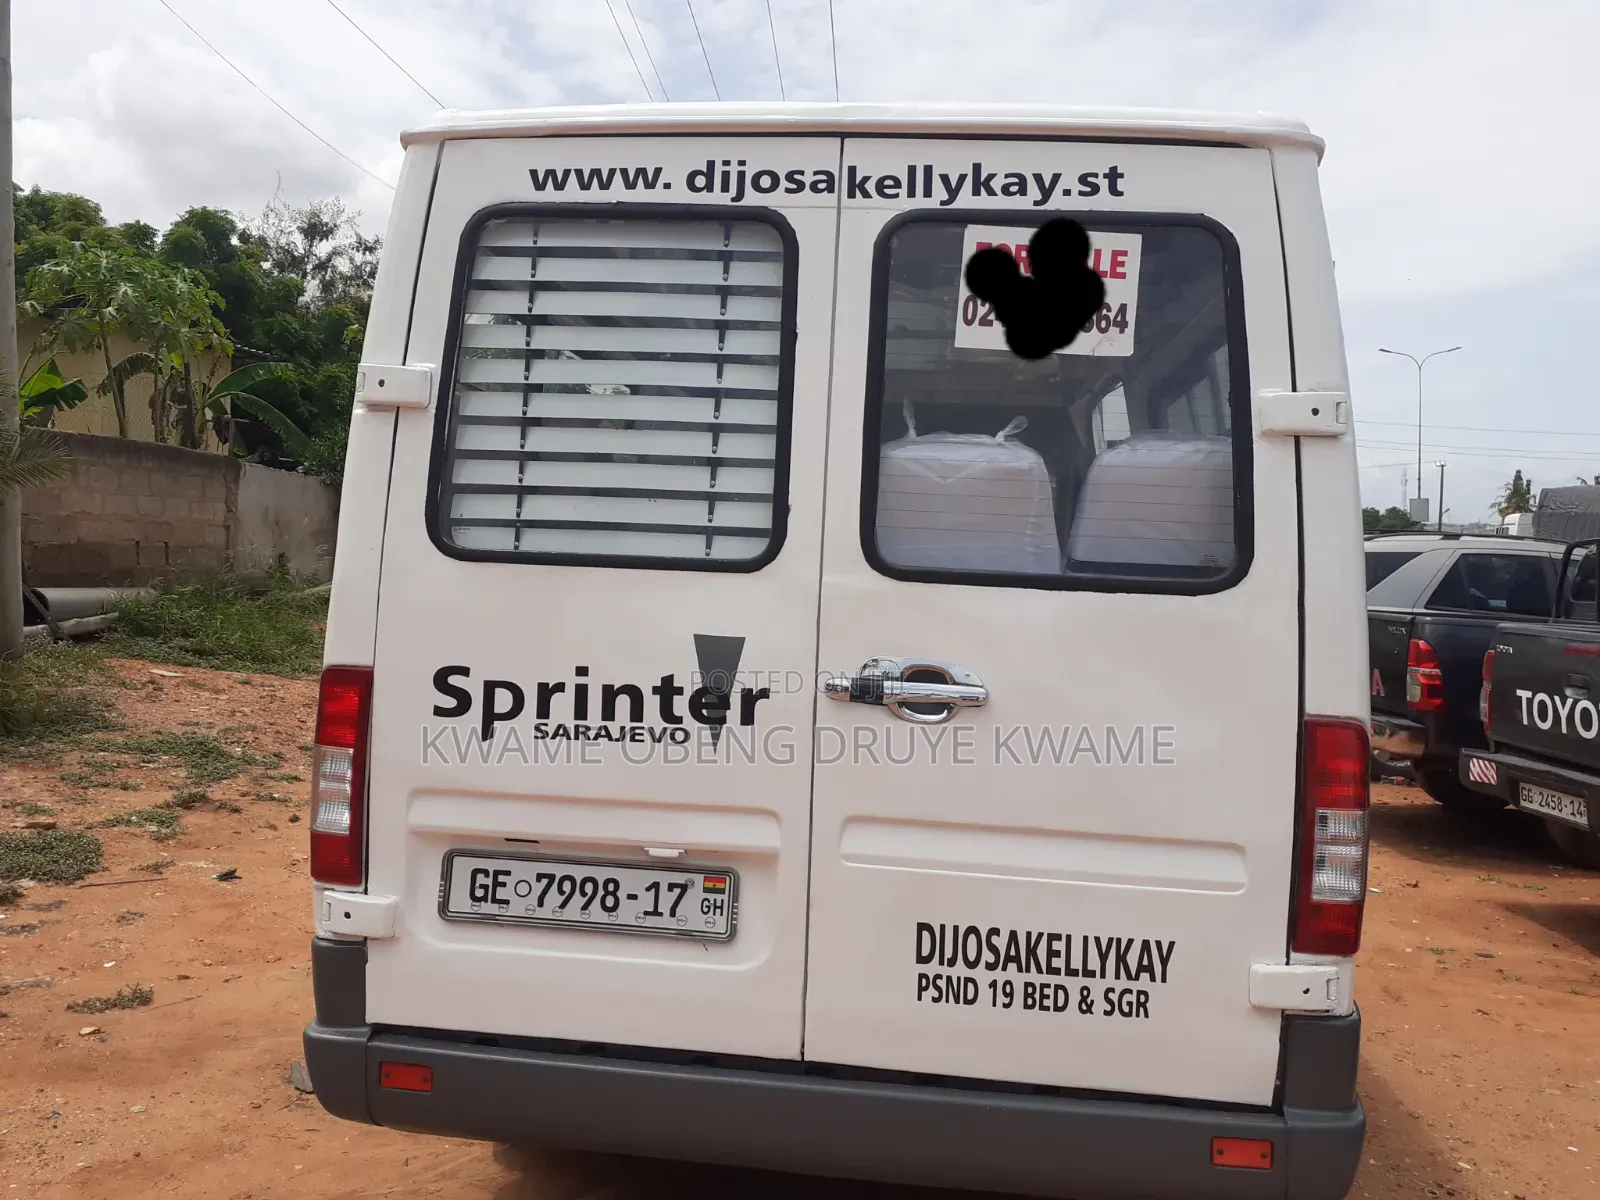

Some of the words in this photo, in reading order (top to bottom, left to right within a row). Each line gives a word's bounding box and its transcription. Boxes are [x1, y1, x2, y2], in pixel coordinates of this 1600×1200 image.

[432, 664, 771, 742] Sprinter
[1516, 688, 1600, 740] TOYO
[533, 722, 692, 745] SARAJEVO
[700, 897, 724, 916] GH
[915, 921, 1176, 984] DIJOSAKELLYKAY
[916, 972, 980, 1006] PSND
[988, 979, 1015, 1009] 19
[1022, 981, 1070, 1013] BED
[1077, 985, 1095, 1015] &
[1102, 987, 1150, 1018] SGR
